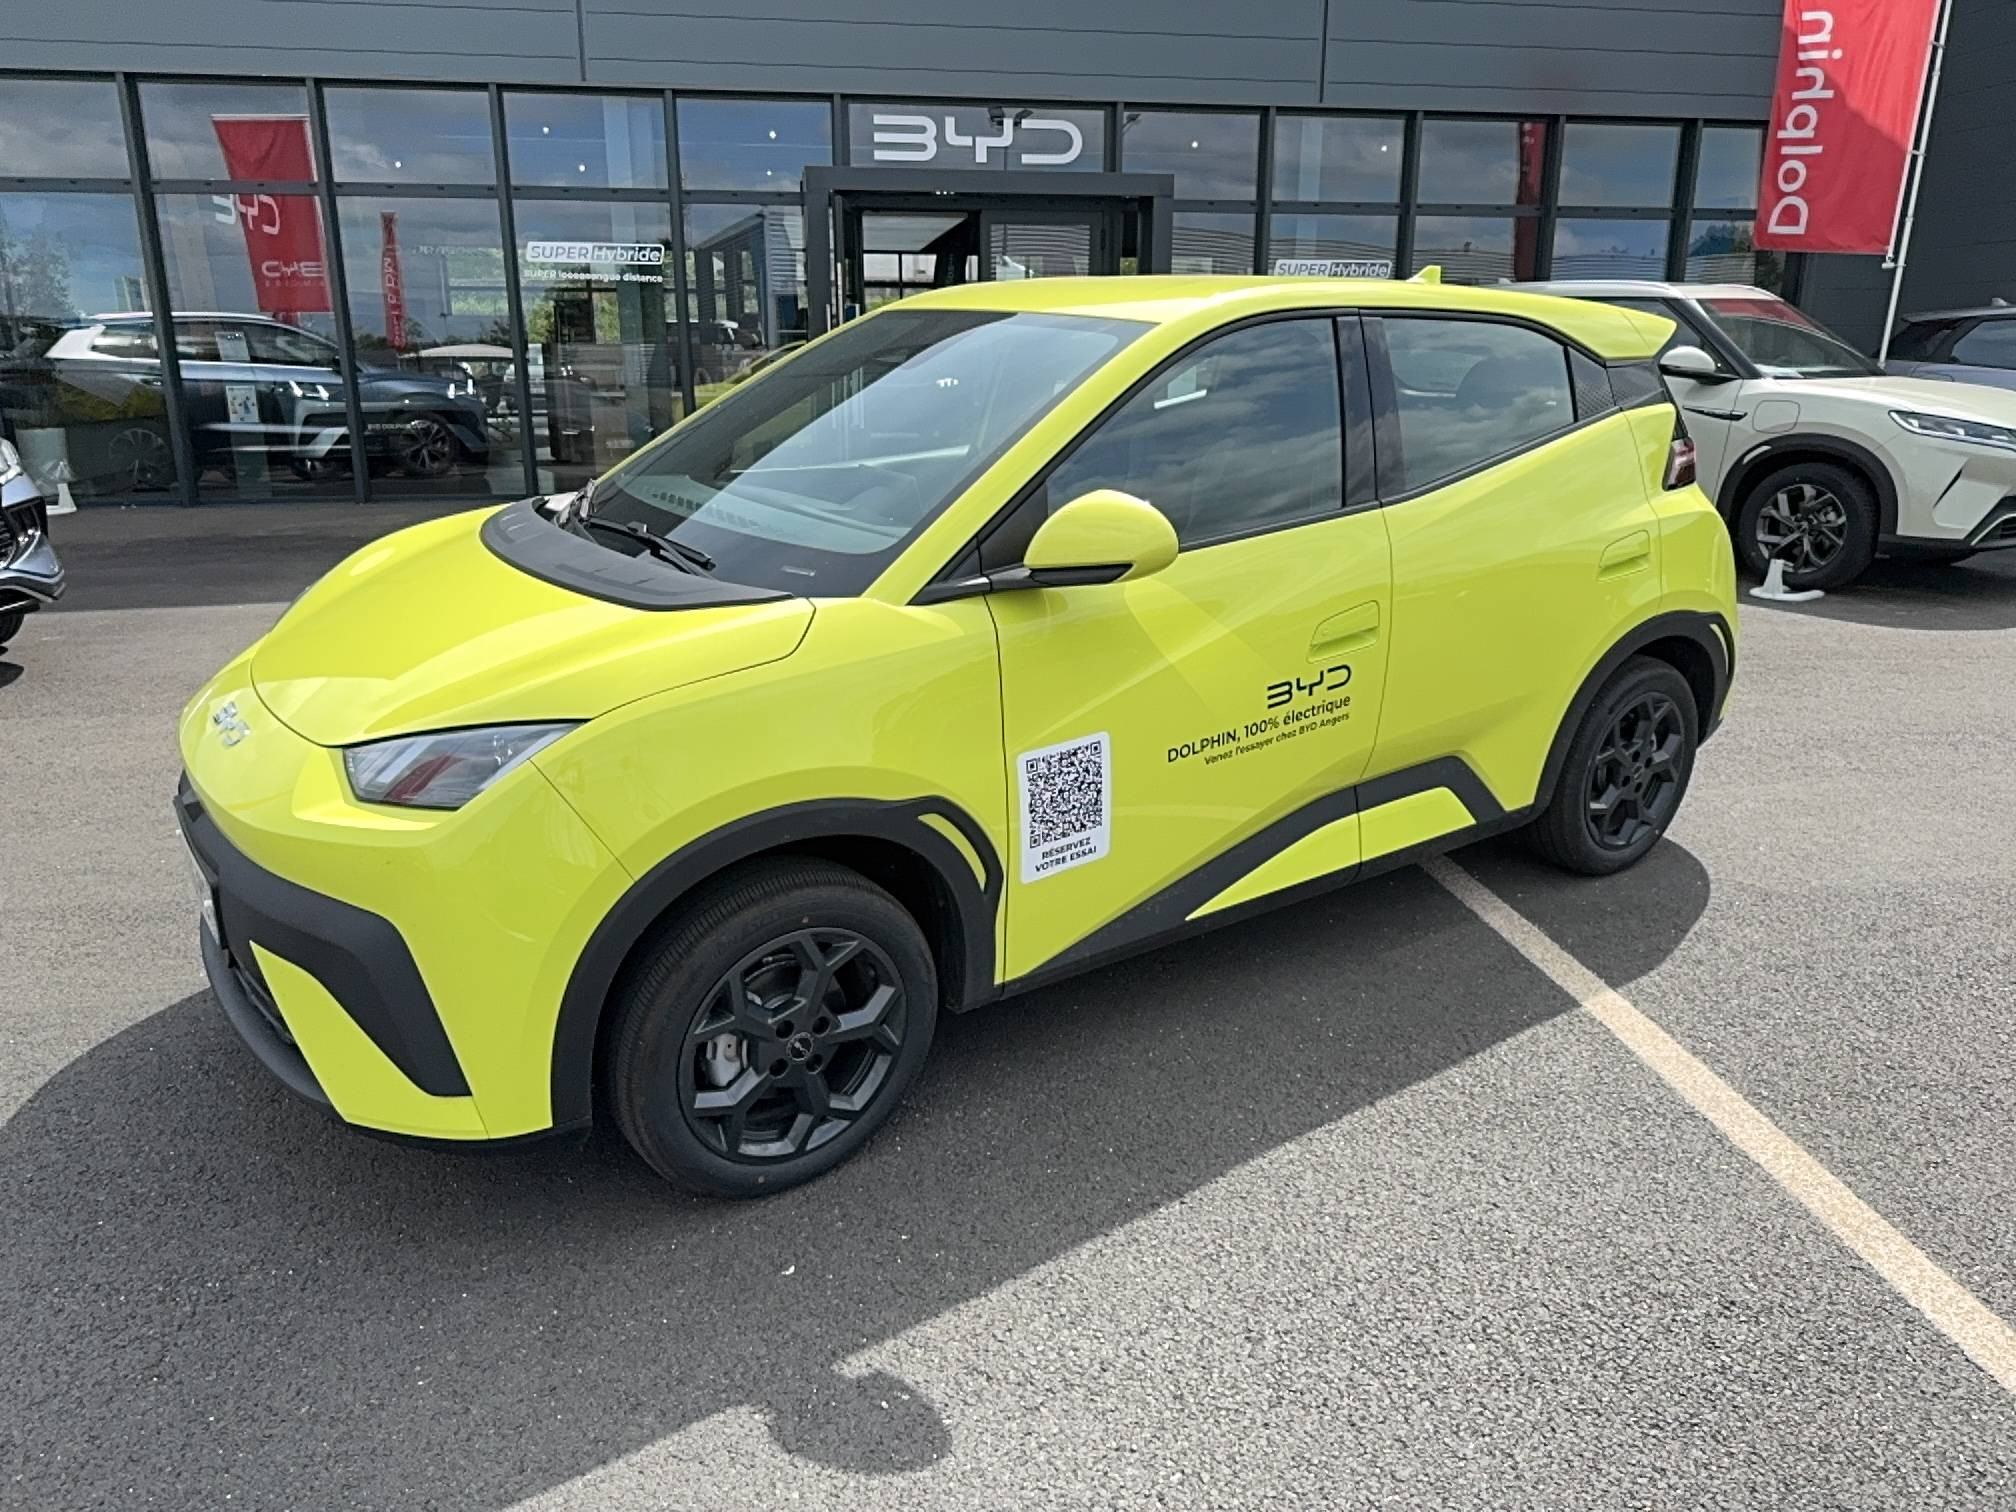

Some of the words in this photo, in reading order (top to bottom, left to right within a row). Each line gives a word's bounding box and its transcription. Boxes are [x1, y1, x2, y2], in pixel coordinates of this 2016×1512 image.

[873, 114, 1083, 165] BYD
[1767, 10, 1843, 235] Dolphin
[531, 245, 588, 259] SUPER
[593, 246, 660, 262] Hybride
[1278, 262, 1328, 276] SUPER
[1330, 263, 1387, 278] Hybride
[524, 269, 556, 280] SUPER
[623, 274, 663, 284] distance
[1267, 664, 1352, 709] BYD
[1168, 730, 1240, 762] DOLPHIN,
[1244, 717, 1280, 738] 100%
[1283, 695, 1351, 725] électrique
[1204, 750, 1233, 765] Venez
[1235, 738, 1274, 757] l'essayer
[1276, 730, 1297, 742] chez
[1299, 722, 1318, 734] BYD
[1319, 713, 1350, 729] Angers
[1035, 856, 1067, 872] VOTRE
[1070, 846, 1097, 861] ESSAI
